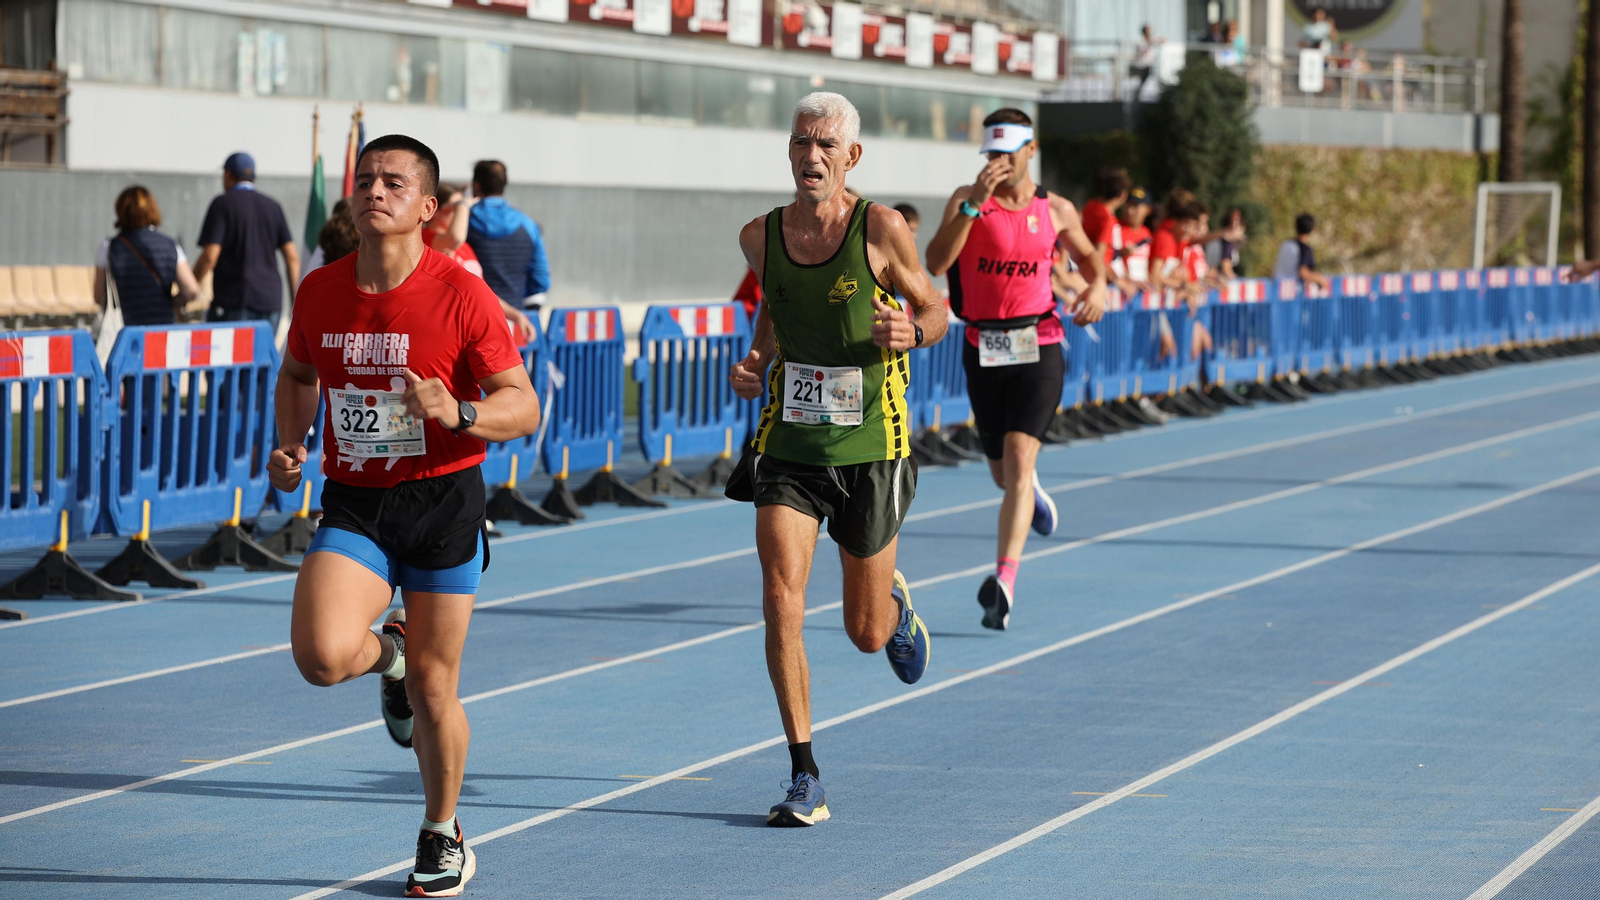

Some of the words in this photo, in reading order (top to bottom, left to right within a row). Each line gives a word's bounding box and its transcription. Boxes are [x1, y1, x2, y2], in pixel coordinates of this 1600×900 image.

[977, 257, 1038, 277] RIVERA
[321, 333, 343, 348] XLII
[343, 332, 410, 350] CARRERA
[985, 335, 1011, 350] 650
[343, 348, 408, 366] POPULAR
[377, 367, 387, 375] DE
[792, 379, 822, 404] 221
[340, 408, 380, 433] 322
